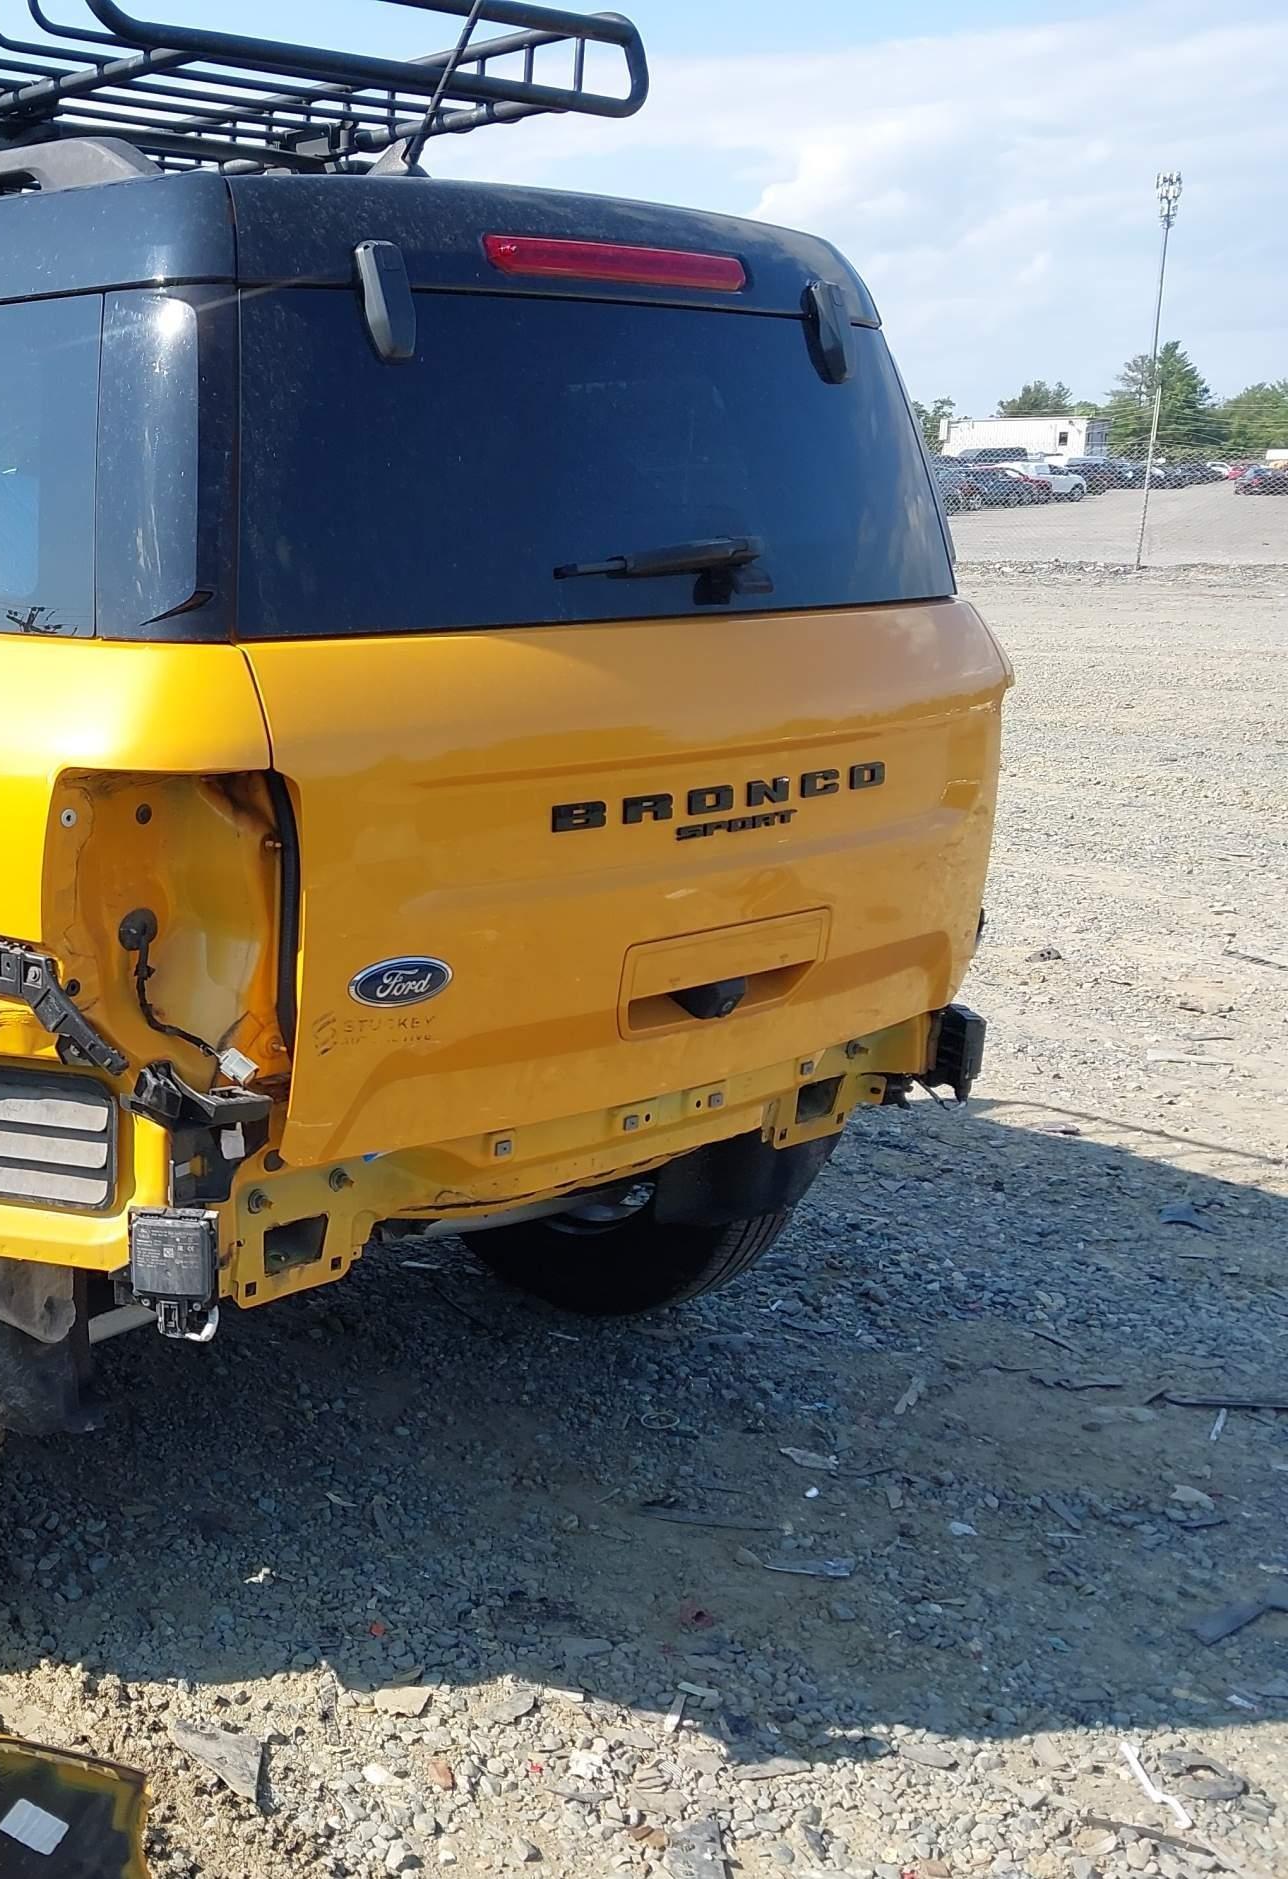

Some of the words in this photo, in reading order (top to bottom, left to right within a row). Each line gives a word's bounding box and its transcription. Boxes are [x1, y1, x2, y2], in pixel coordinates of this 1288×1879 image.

[551, 761, 886, 833] BRONCO
[675, 808, 798, 841] SPORT
[375, 968, 433, 998] Ford
